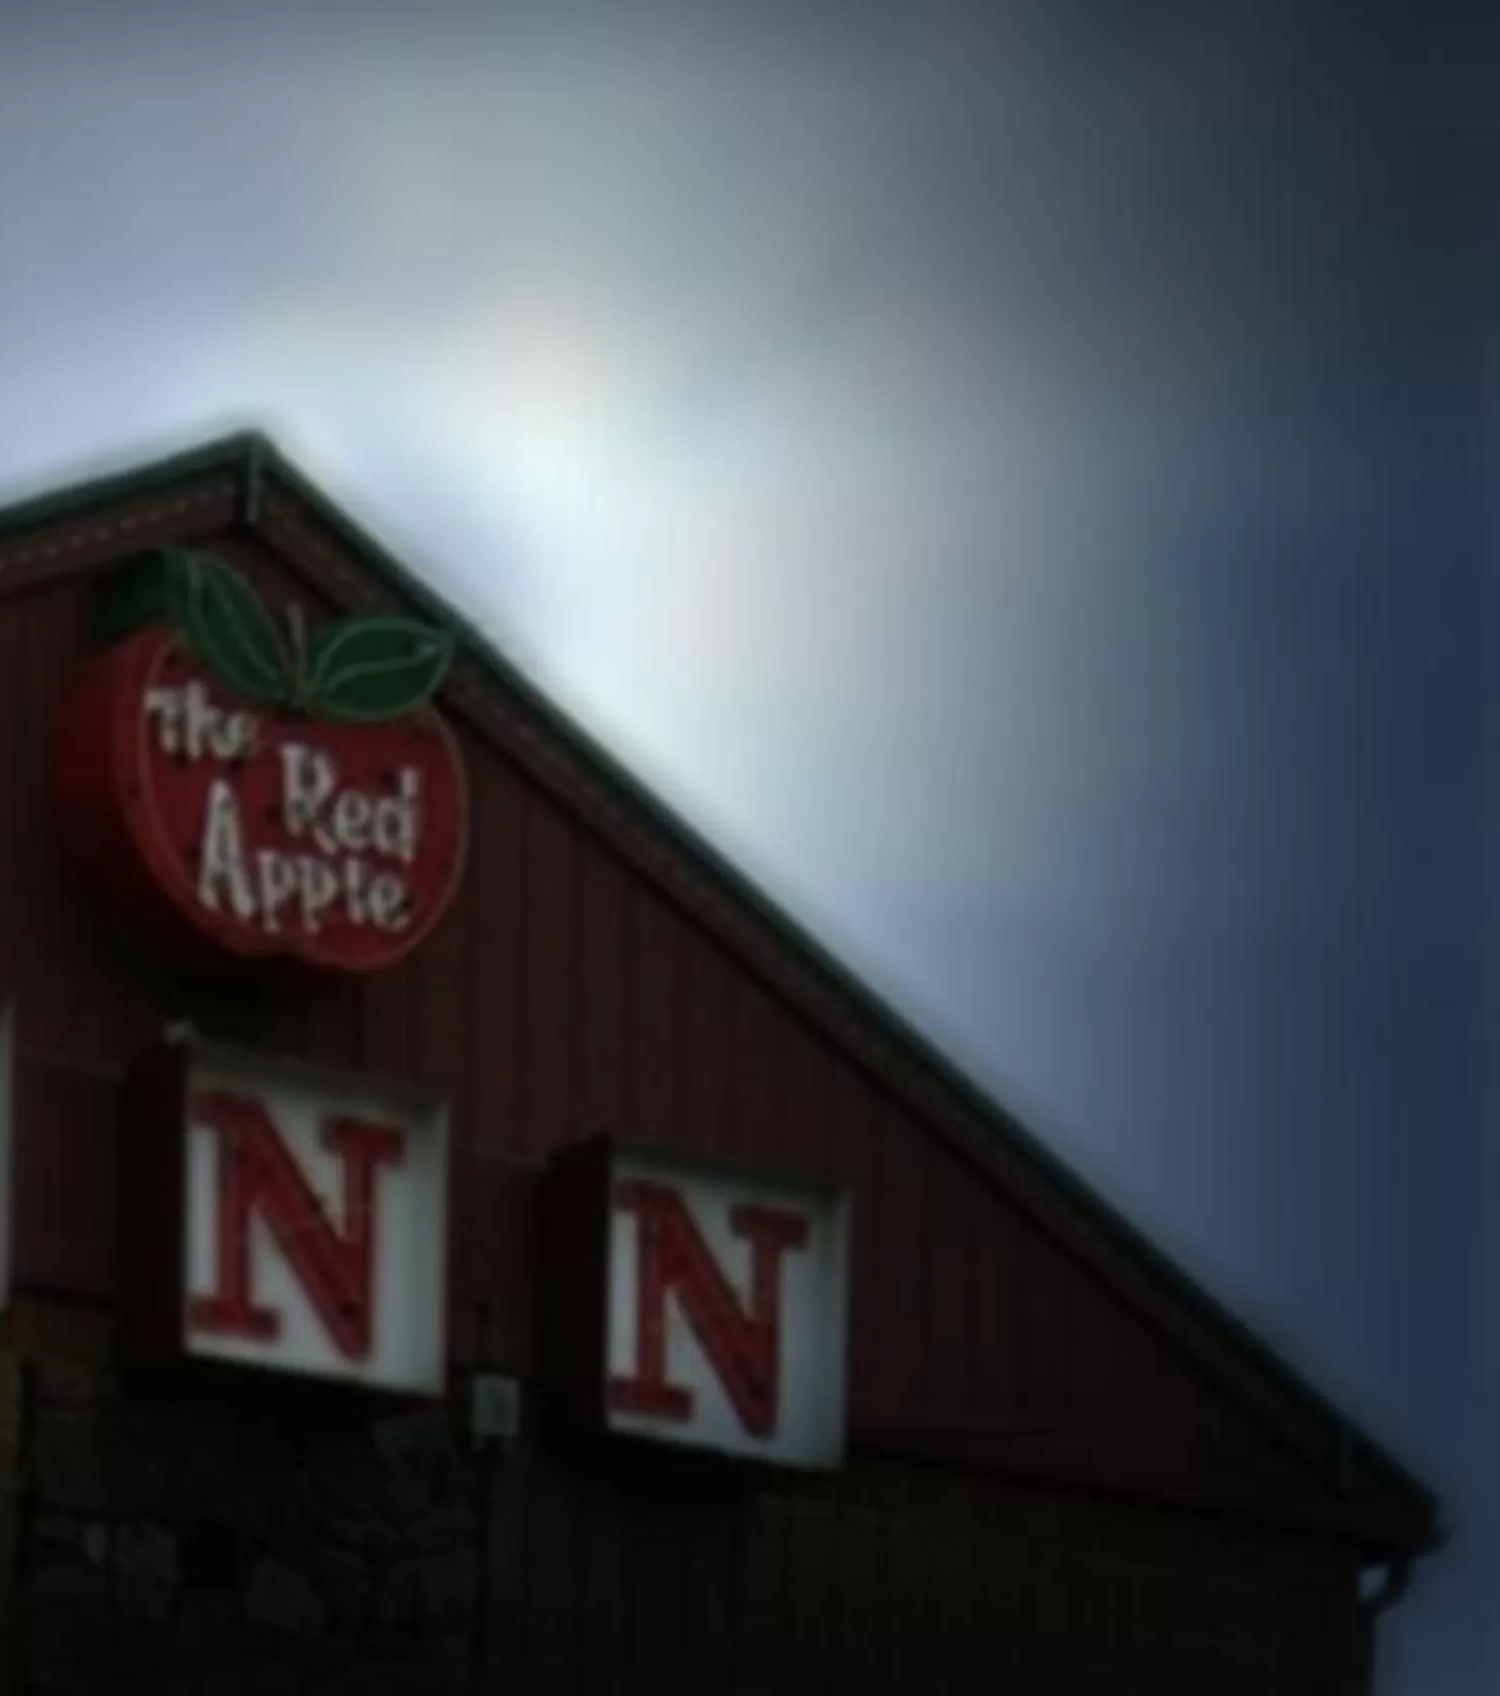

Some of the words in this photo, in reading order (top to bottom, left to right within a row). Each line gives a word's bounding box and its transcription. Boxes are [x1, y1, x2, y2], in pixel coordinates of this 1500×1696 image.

[144, 679, 256, 760] The
[199, 777, 409, 934] Apple
[279, 741, 419, 864] Red
